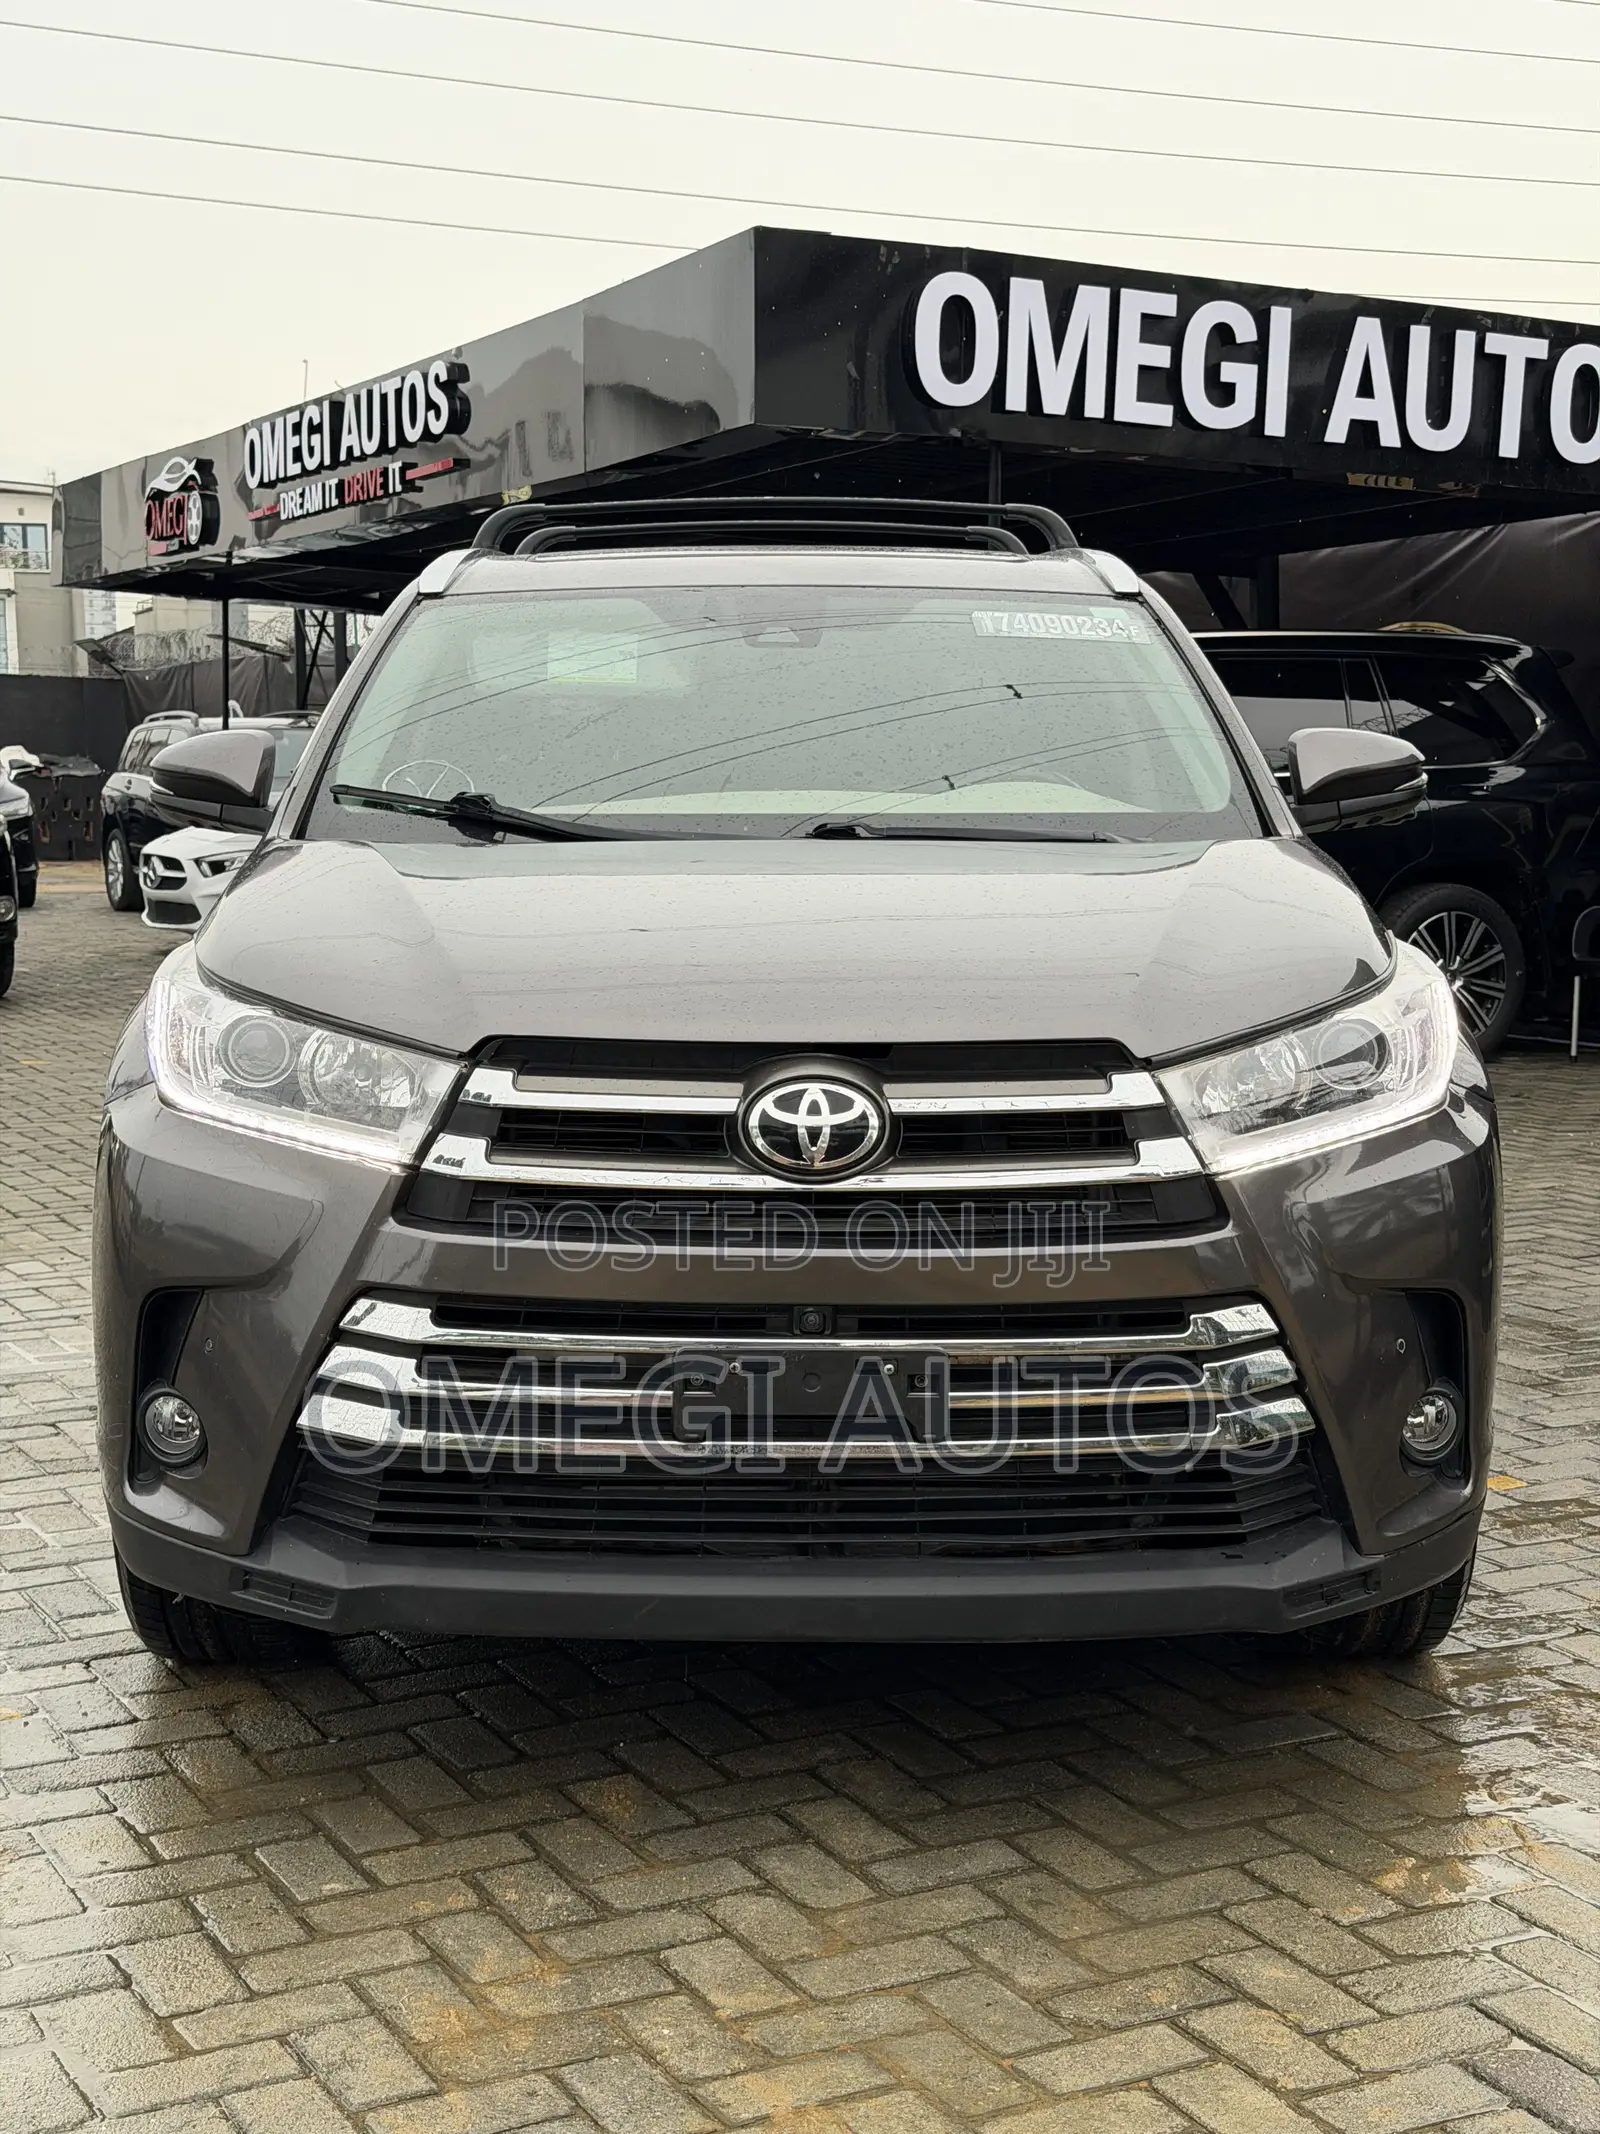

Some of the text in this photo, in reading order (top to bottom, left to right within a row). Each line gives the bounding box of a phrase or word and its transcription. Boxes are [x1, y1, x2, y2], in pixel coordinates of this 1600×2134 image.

[914, 271, 1292, 438] OMEGI
[243, 360, 449, 489] OMEGI AUTOS
[279, 483, 324, 522] DREAM
[343, 467, 384, 504] DRIVE
